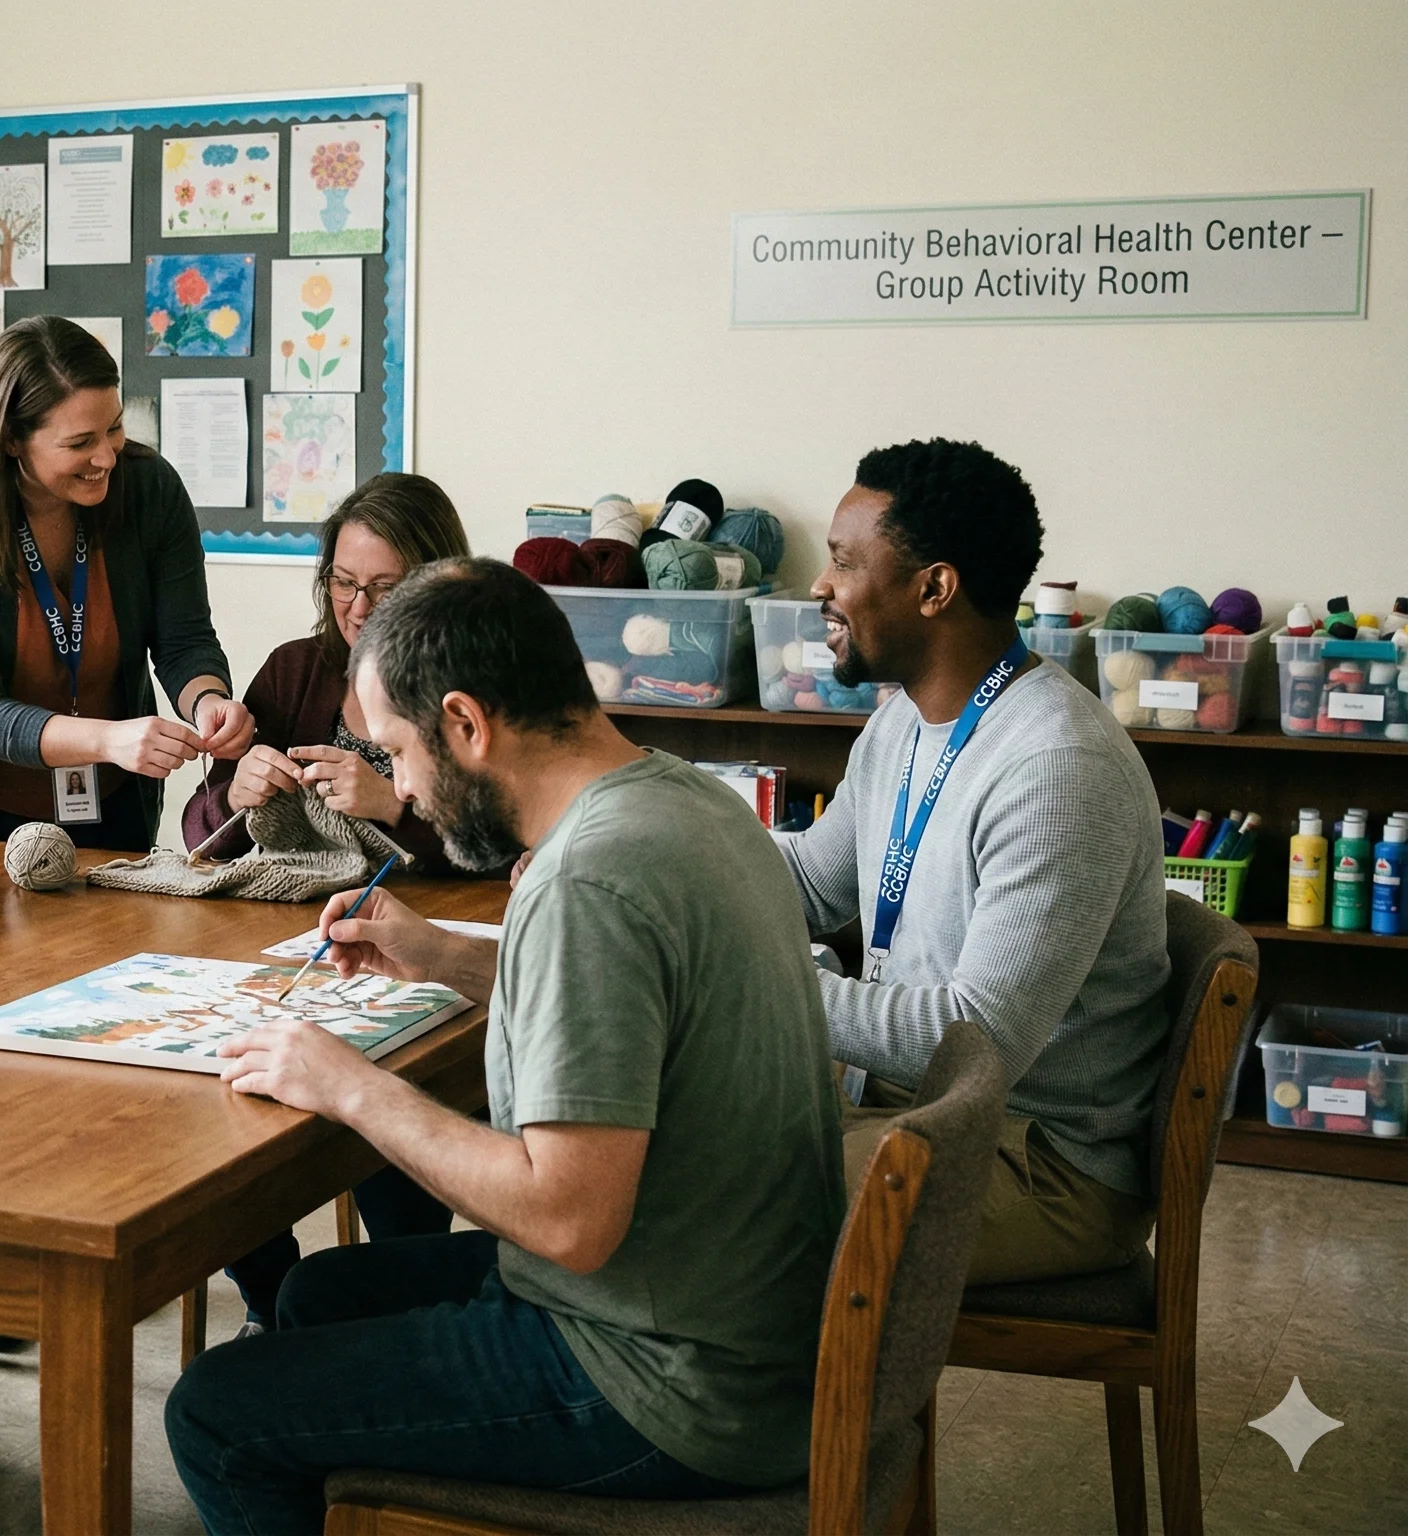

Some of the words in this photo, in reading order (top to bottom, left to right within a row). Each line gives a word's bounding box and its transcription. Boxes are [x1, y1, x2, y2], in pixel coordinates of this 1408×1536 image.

[753, 231, 915, 265] Community
[926, 225, 1081, 258] Behavioral
[1095, 222, 1192, 254] Health
[1205, 220, 1311, 251] Center
[876, 270, 963, 304] Group
[974, 267, 1086, 302] Activity
[1098, 266, 1189, 294] Room
[17, 521, 42, 572] CCBHC
[45, 607, 69, 654] CCBHC
[973, 660, 1014, 707] CCBHC
[886, 845, 914, 903] CCBHC
